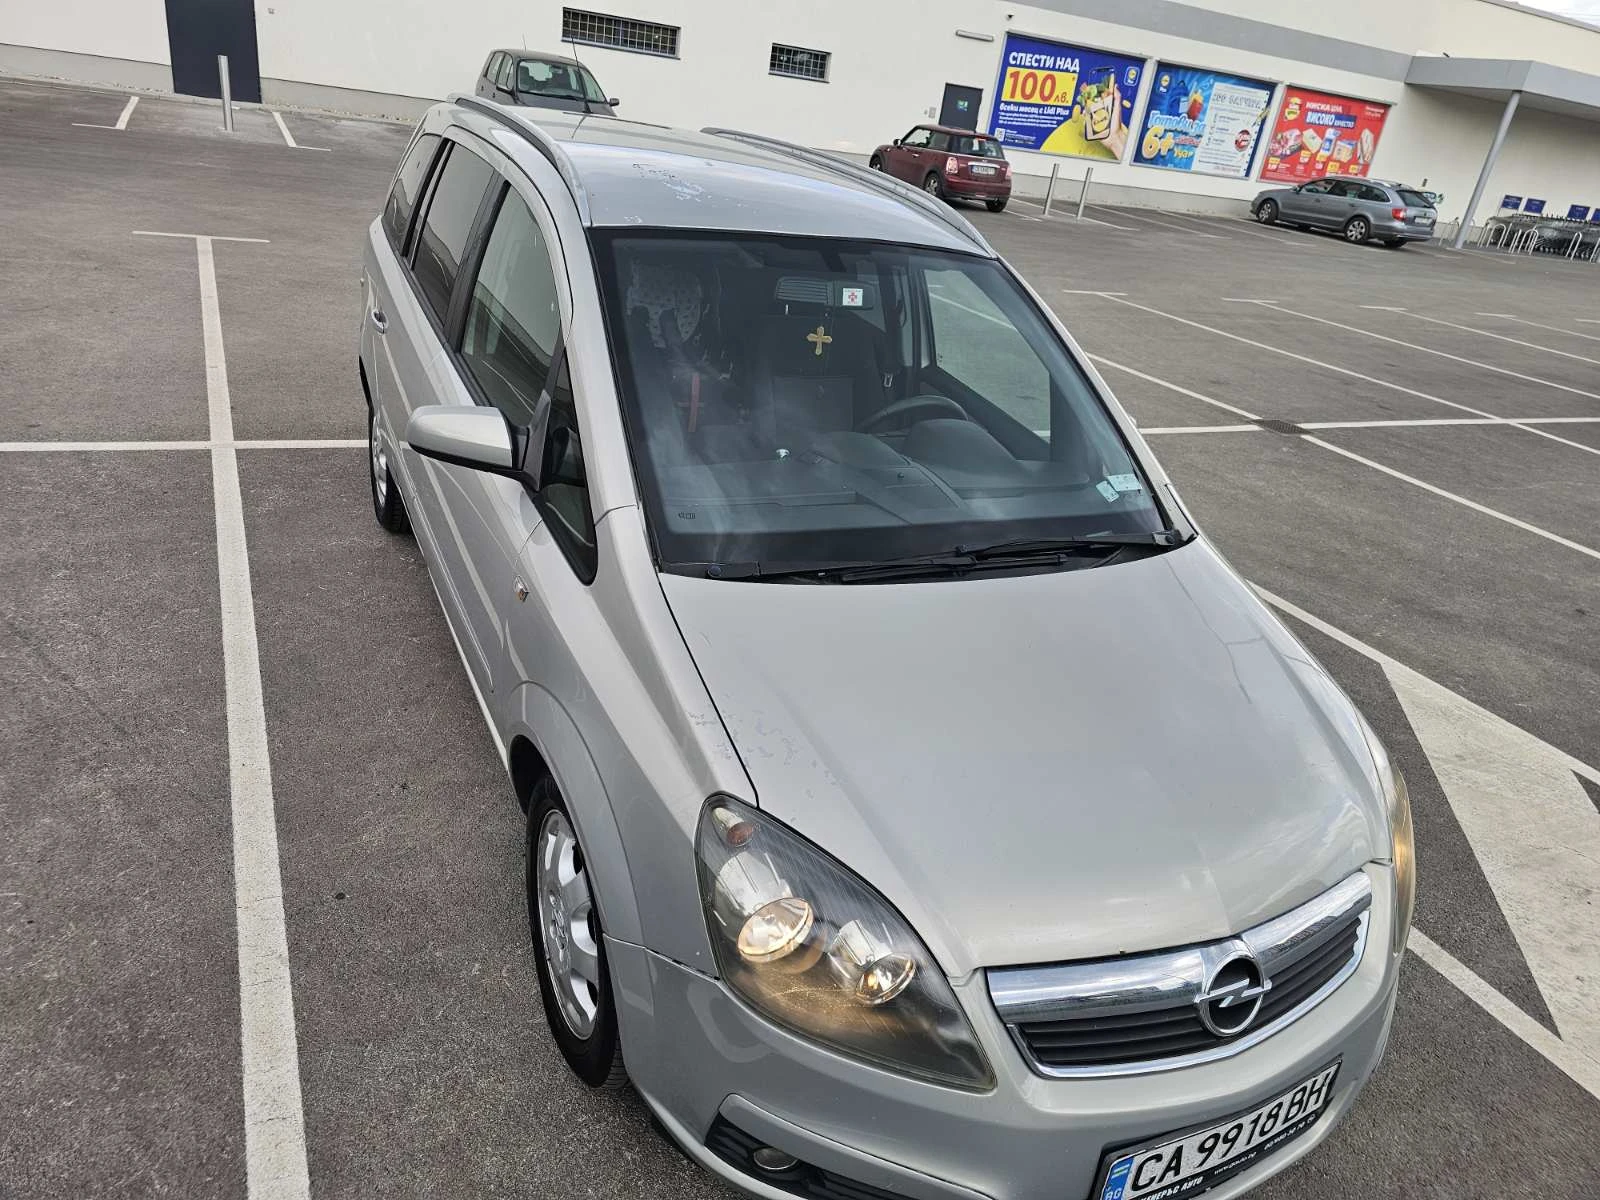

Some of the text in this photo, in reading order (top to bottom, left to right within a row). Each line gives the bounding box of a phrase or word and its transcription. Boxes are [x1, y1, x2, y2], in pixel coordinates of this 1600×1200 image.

[1009, 52, 1080, 73] СПЕСТИ НАД
[1009, 70, 1056, 102] 100
[1131, 1144, 1184, 1192] CA
[1196, 1101, 1284, 1168] 9918
[1281, 1072, 1331, 1126] BH
